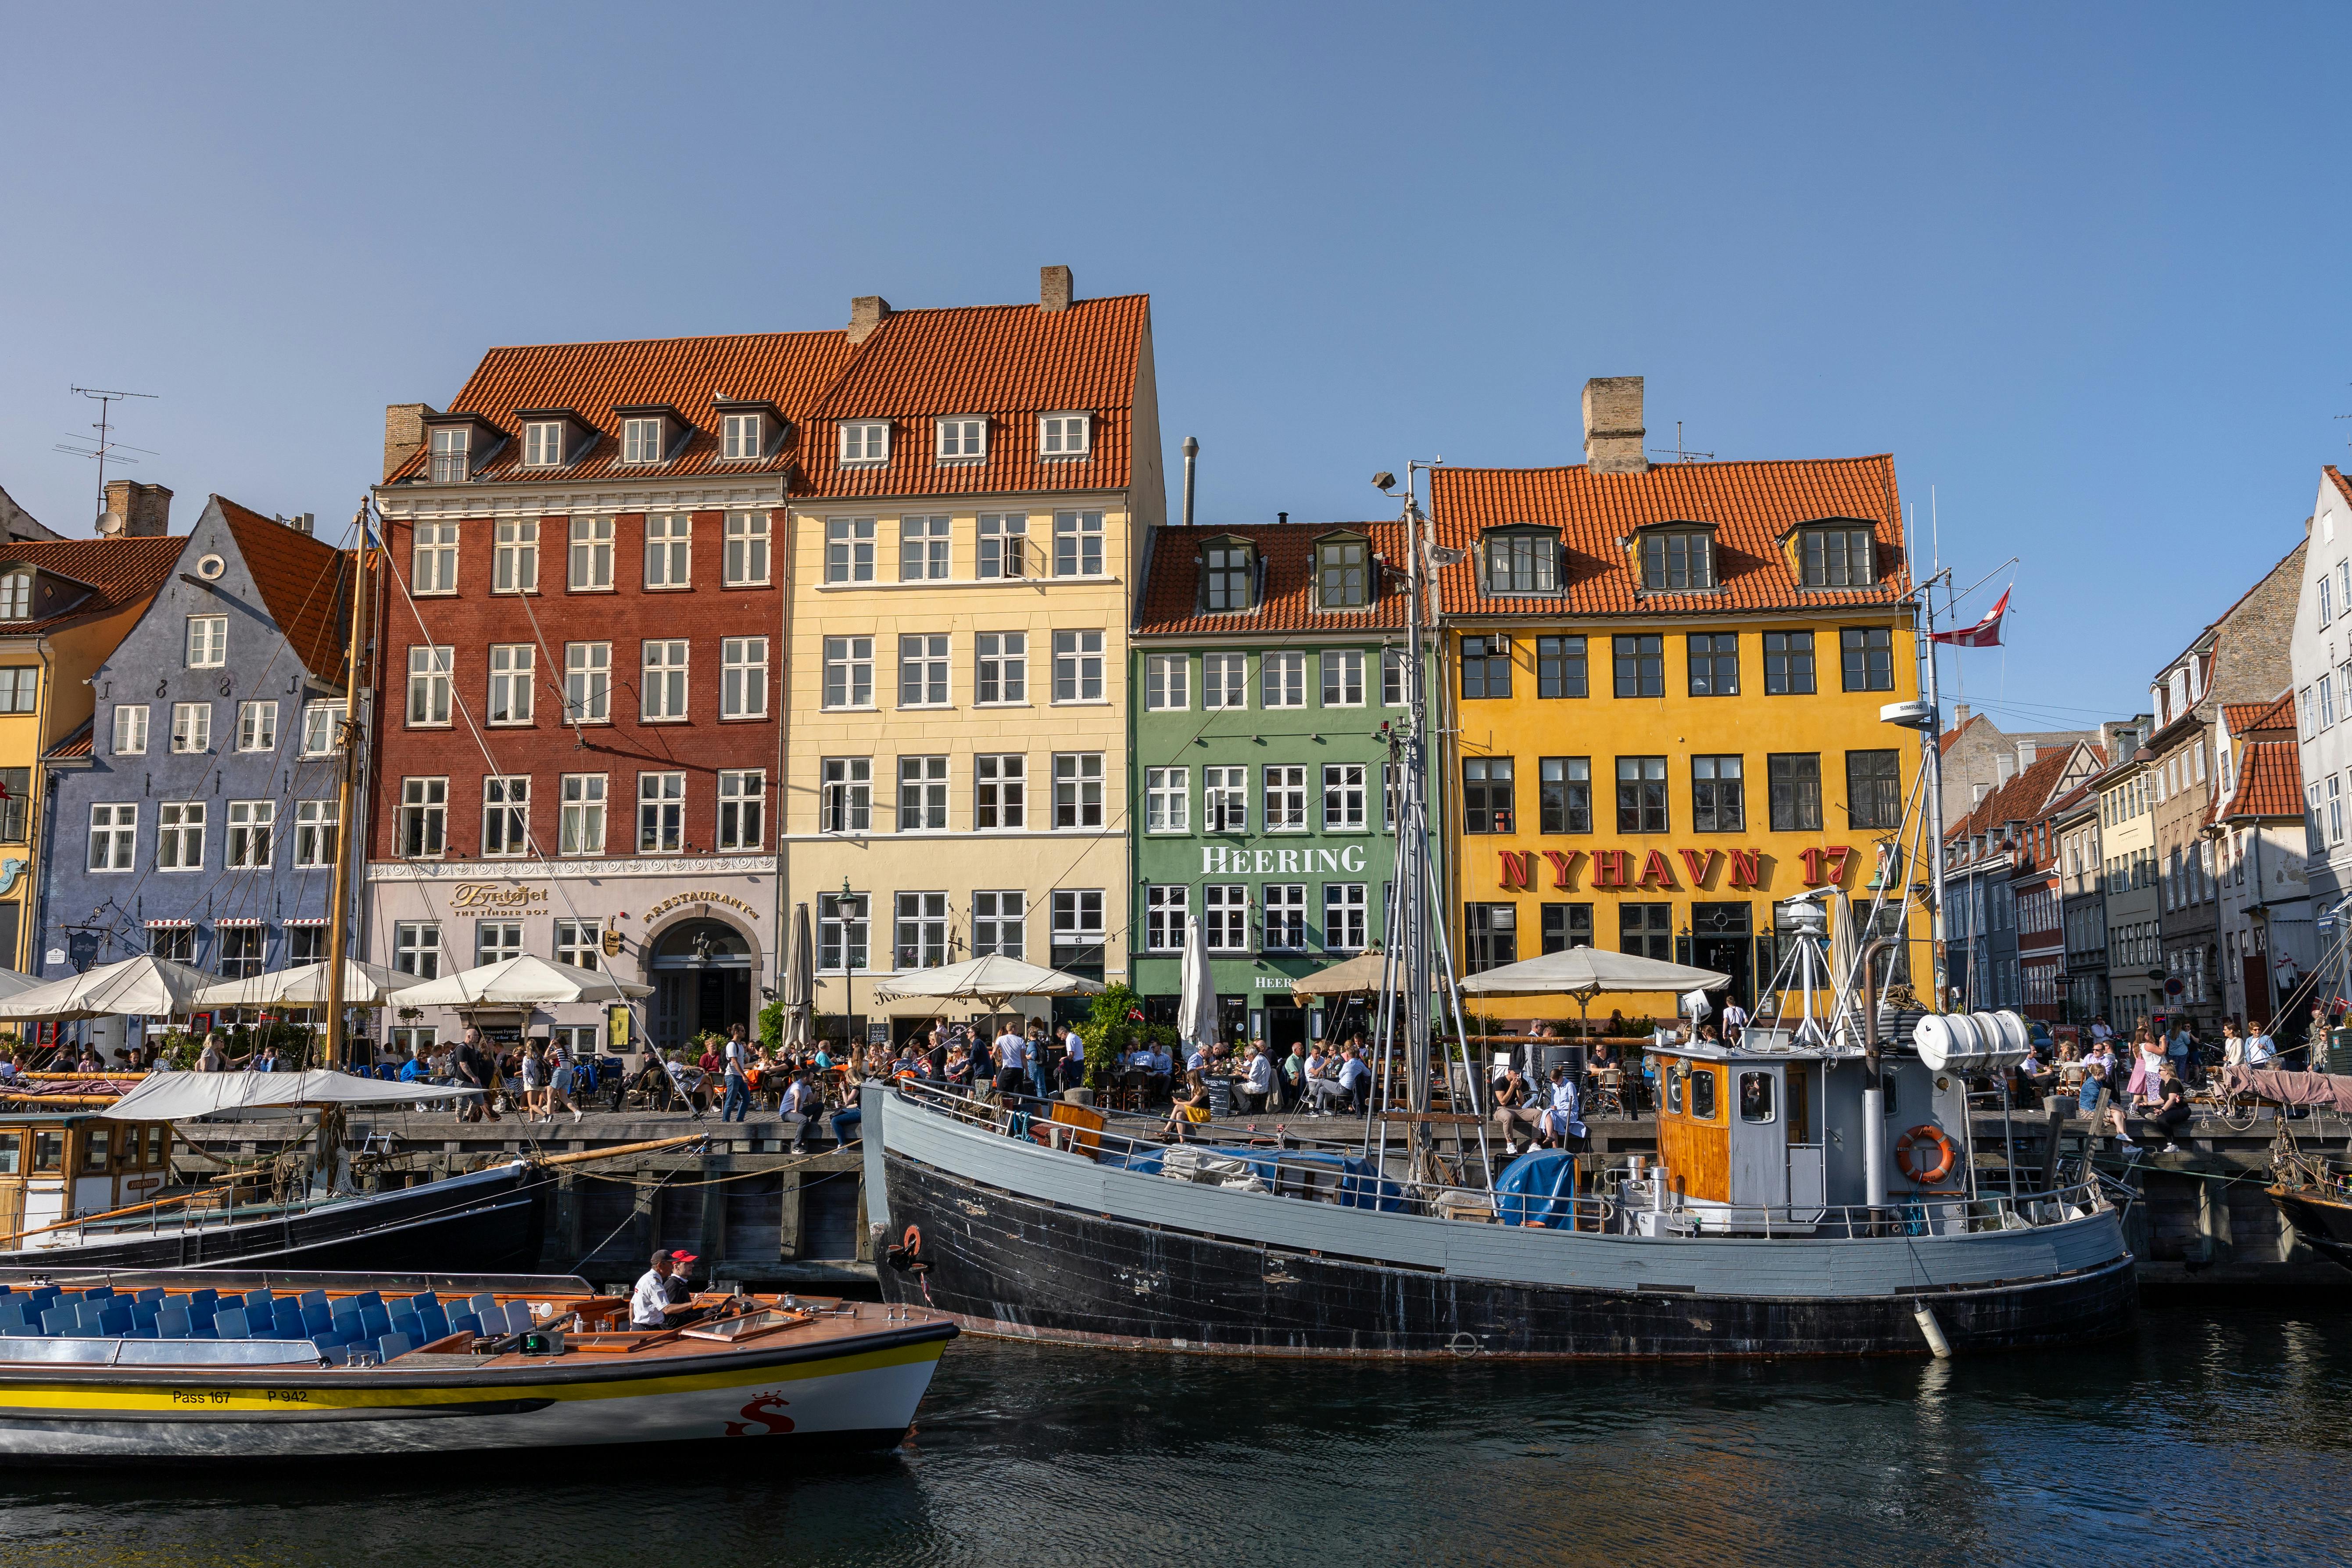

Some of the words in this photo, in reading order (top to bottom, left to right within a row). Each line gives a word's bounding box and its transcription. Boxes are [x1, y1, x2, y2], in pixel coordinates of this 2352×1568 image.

[1200, 845, 1367, 873] HEERING
[1498, 848, 1761, 887] NYHAVN
[1798, 845, 1851, 884] 17
[652, 891, 752, 914] RESTAURANT
[1255, 977, 1296, 988] HEER
[173, 1391, 205, 1403] Pass
[208, 1391, 231, 1403] 167
[268, 1390, 277, 1402] P
[281, 1391, 308, 1402] 942
